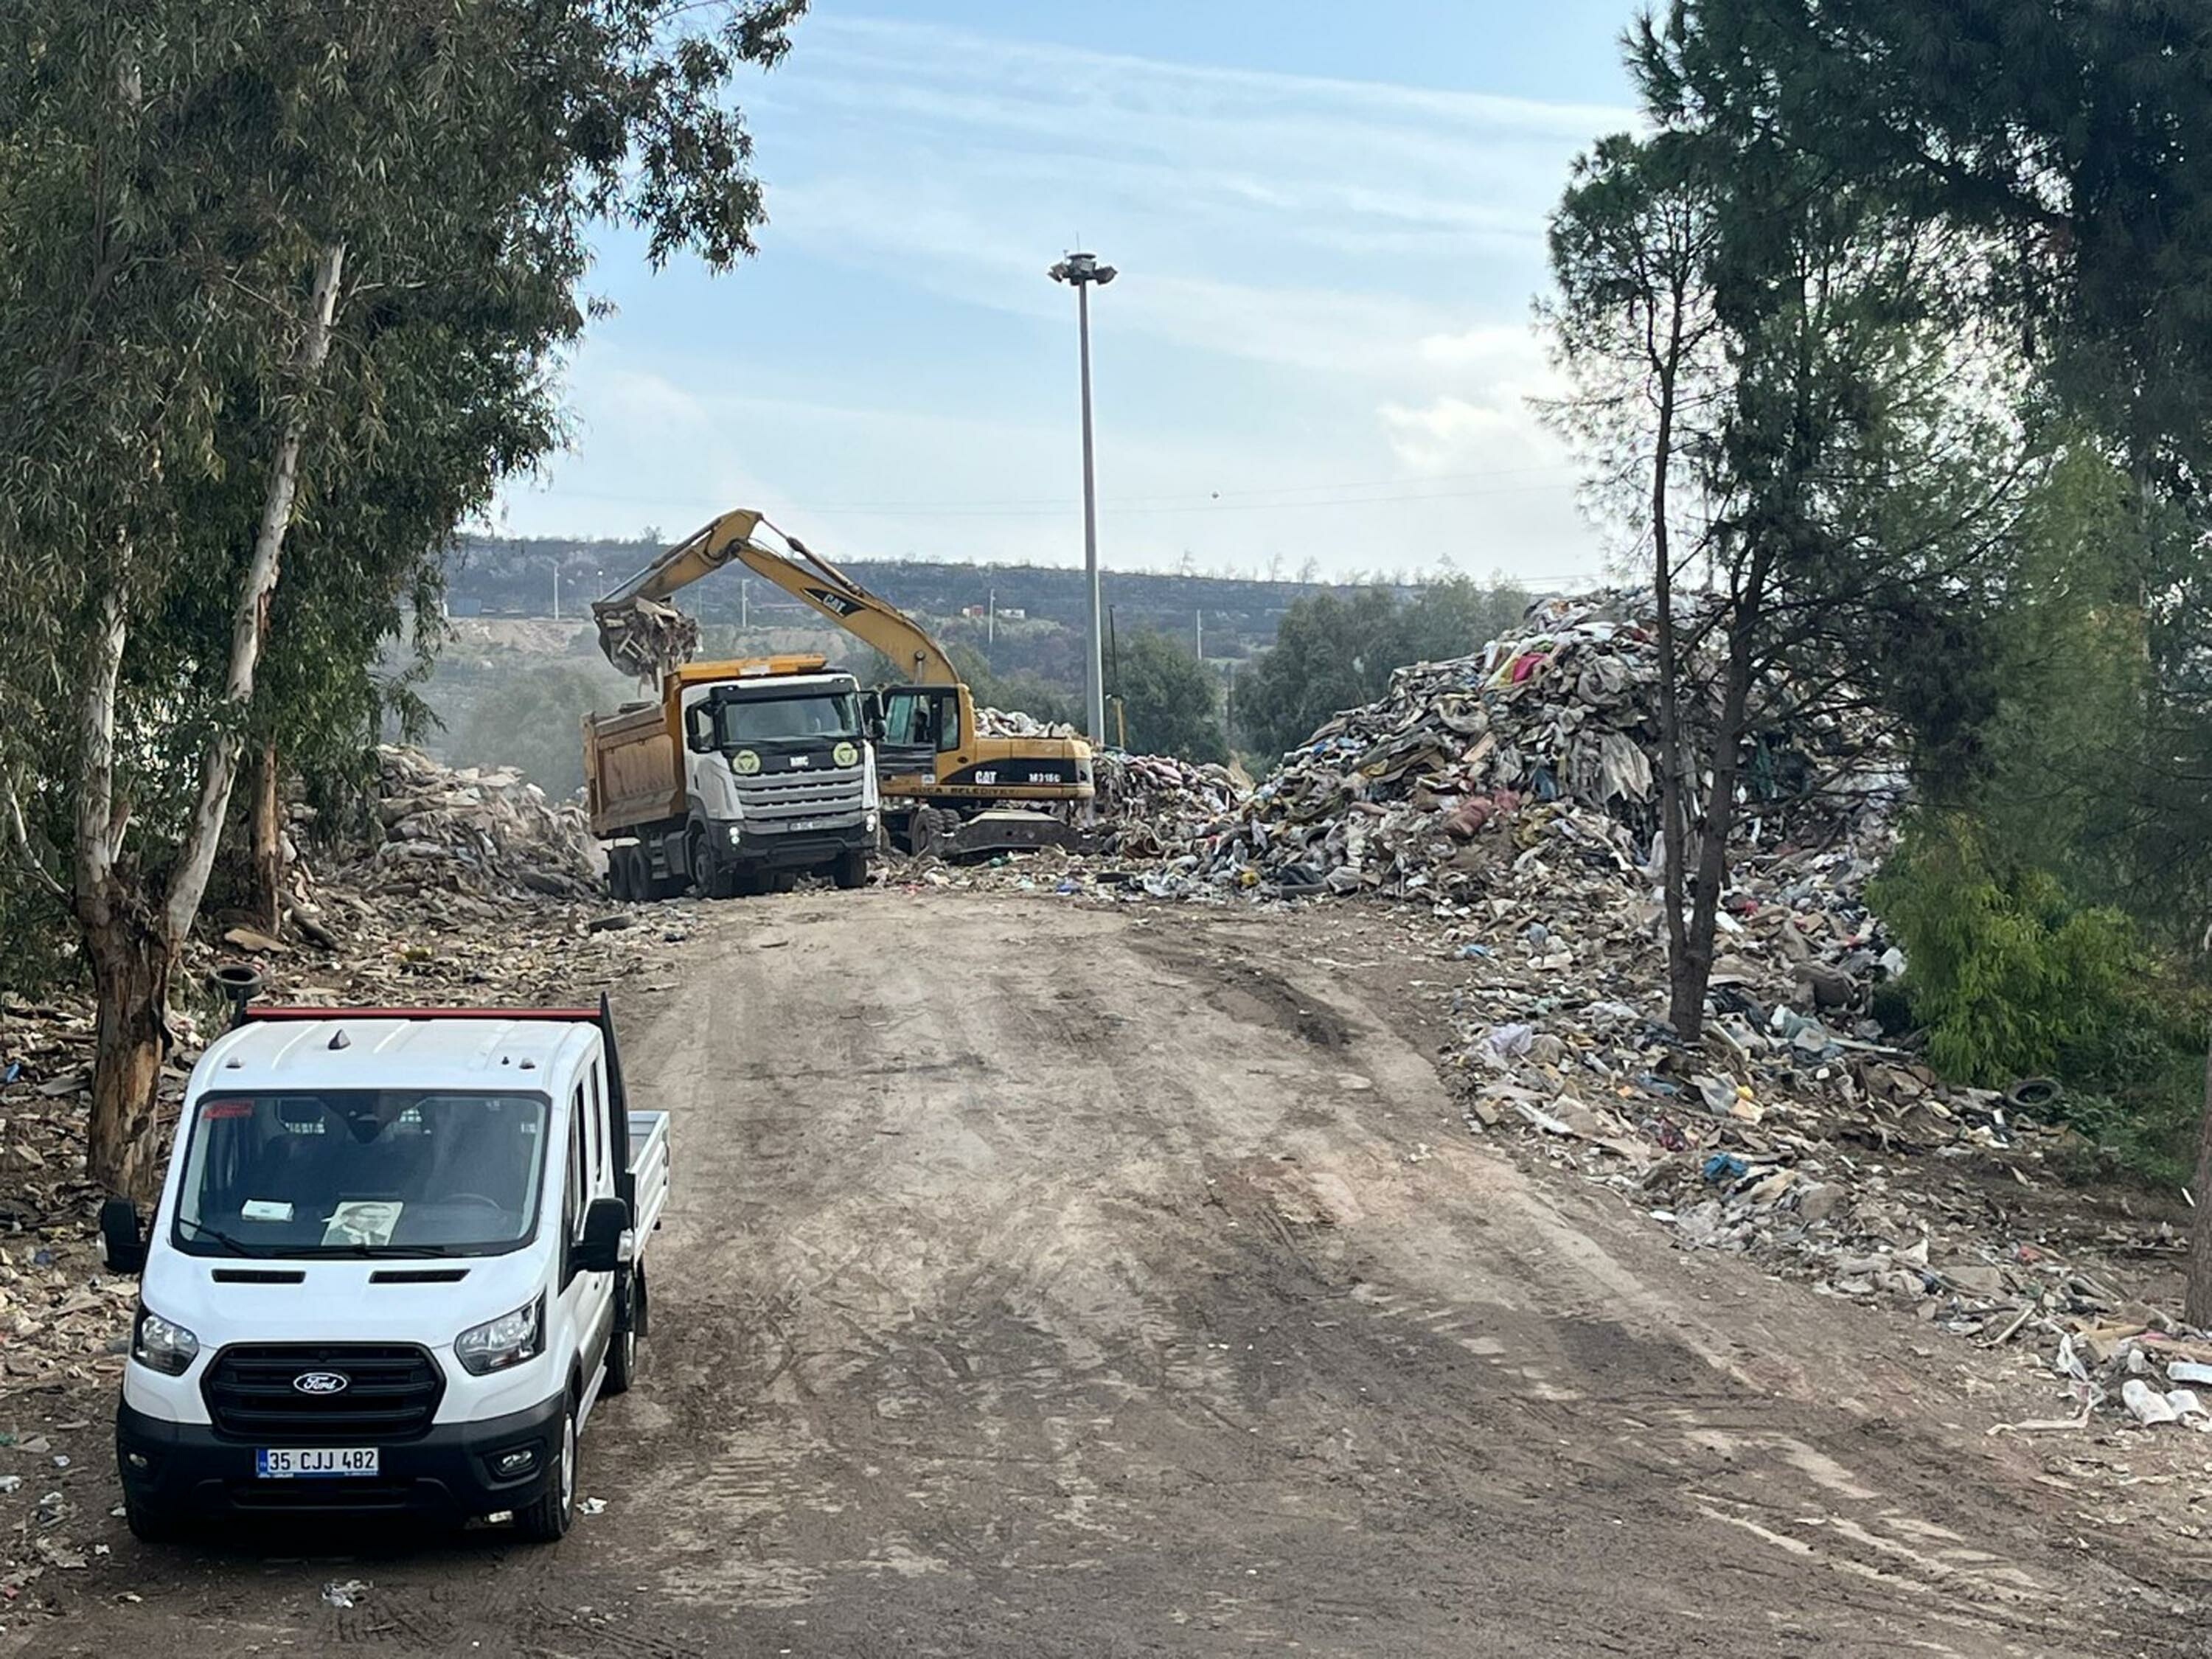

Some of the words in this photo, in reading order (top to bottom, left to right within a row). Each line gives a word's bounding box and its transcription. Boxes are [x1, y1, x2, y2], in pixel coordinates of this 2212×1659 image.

[823, 594, 846, 613] CAT
[975, 770, 997, 785] CAT
[303, 1377, 337, 1390] Ford
[270, 1453, 291, 1470] 35
[301, 1452, 333, 1470] CJJ
[342, 1451, 375, 1469] 482
